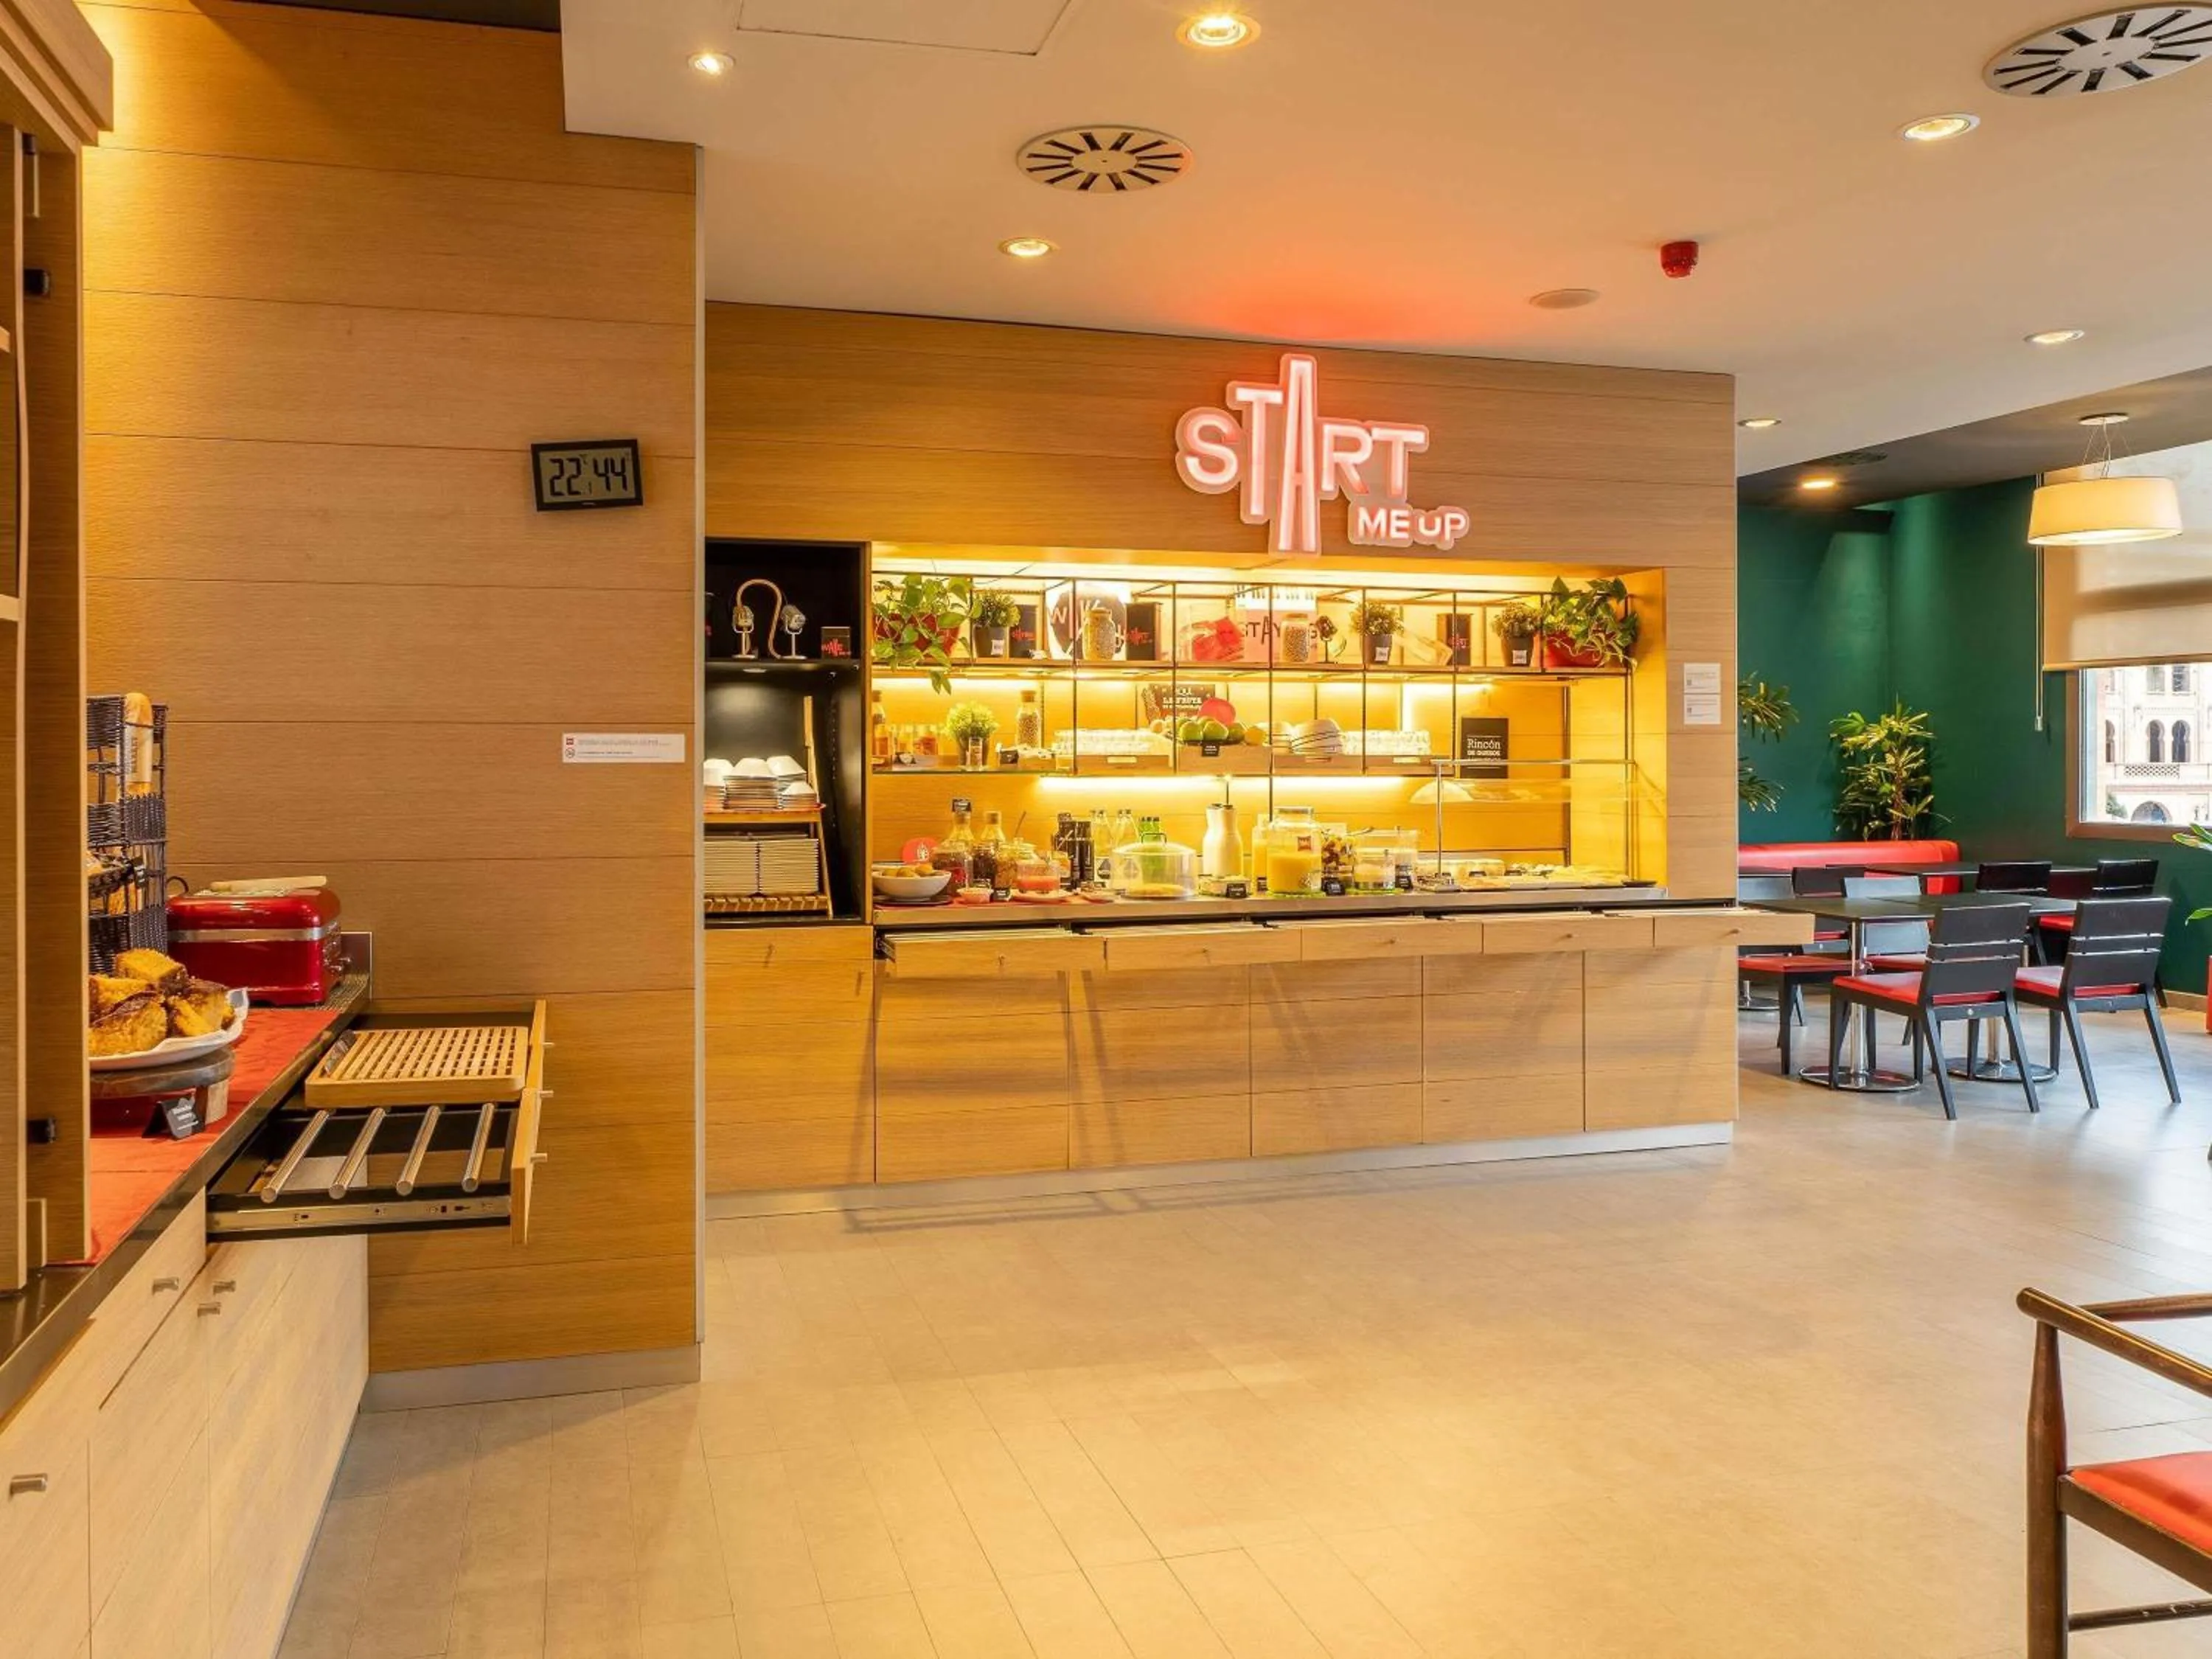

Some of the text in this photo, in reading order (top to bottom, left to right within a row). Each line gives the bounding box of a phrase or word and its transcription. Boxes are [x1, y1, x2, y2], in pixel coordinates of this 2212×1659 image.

[1183, 358, 1426, 553] START
[1357, 507, 1467, 541] ME UP
[1467, 737, 1501, 750] Rincón
